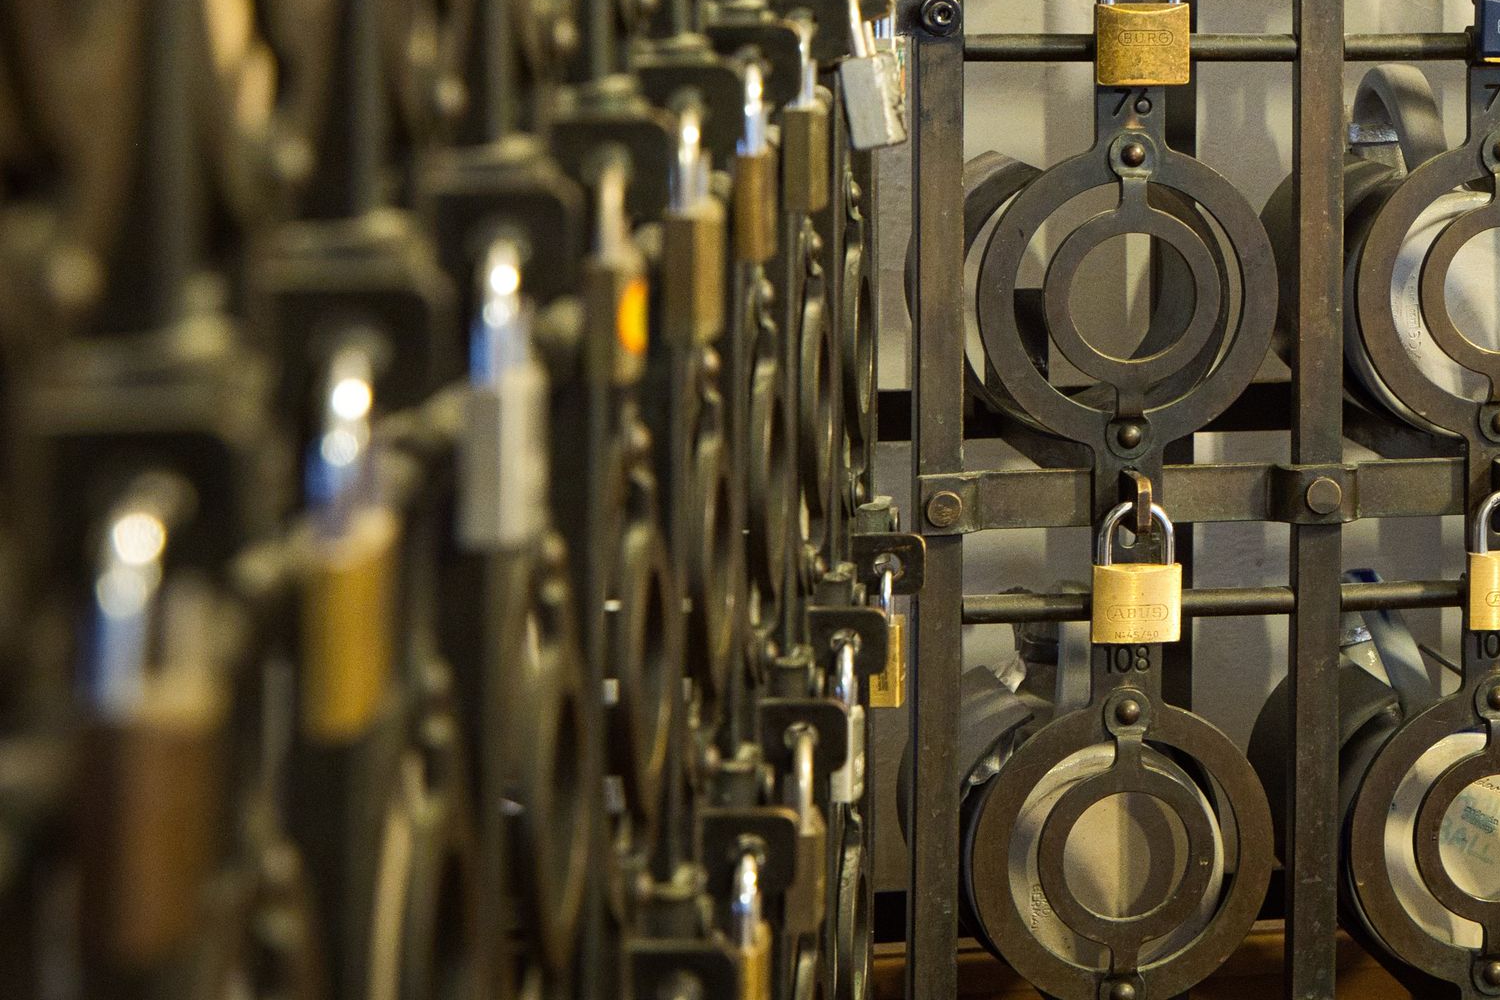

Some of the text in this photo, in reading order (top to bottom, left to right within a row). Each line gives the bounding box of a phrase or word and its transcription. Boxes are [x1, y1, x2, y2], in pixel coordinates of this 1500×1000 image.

[1123, 32, 1170, 45] BURG
[1111, 87, 1153, 118] 76
[1111, 607, 1163, 620] ABUS
[1103, 645, 1151, 674] 108
